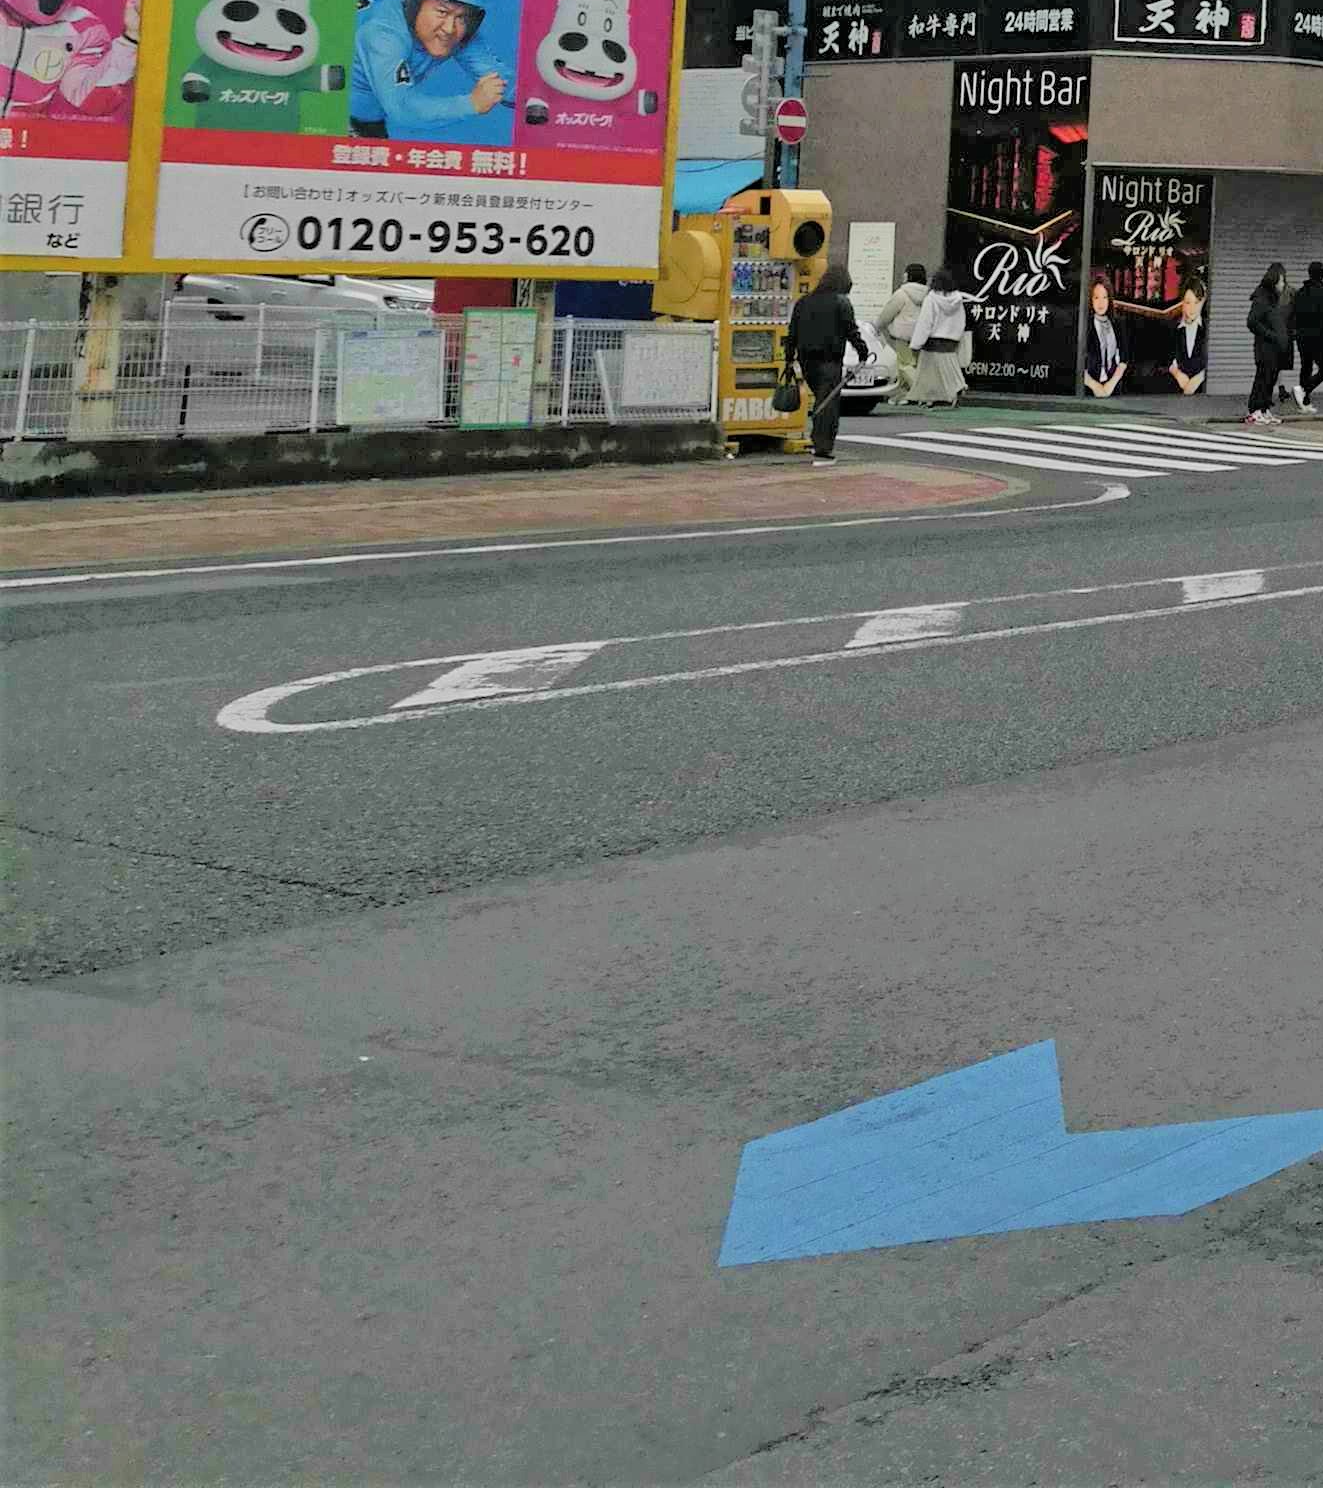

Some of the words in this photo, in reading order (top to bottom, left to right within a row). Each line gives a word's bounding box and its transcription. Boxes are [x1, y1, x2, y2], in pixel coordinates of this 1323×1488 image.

[908, 12, 976, 39] 和牛専門
[1004, 8, 1075, 33] 24時間営業
[818, 19, 869, 56] 天神
[959, 69, 1033, 114] Night
[1040, 70, 1088, 106] Bar
[471, 149, 527, 176] 無料!
[1102, 175, 1161, 207] Night
[1168, 179, 1206, 204] Bar
[47, 232, 80, 249] など
[297, 215, 595, 257] 0120-953-620
[970, 304, 1020, 323] サロンド
[1026, 305, 1049, 324] リオ
[1030, 364, 1049, 379] LAST
